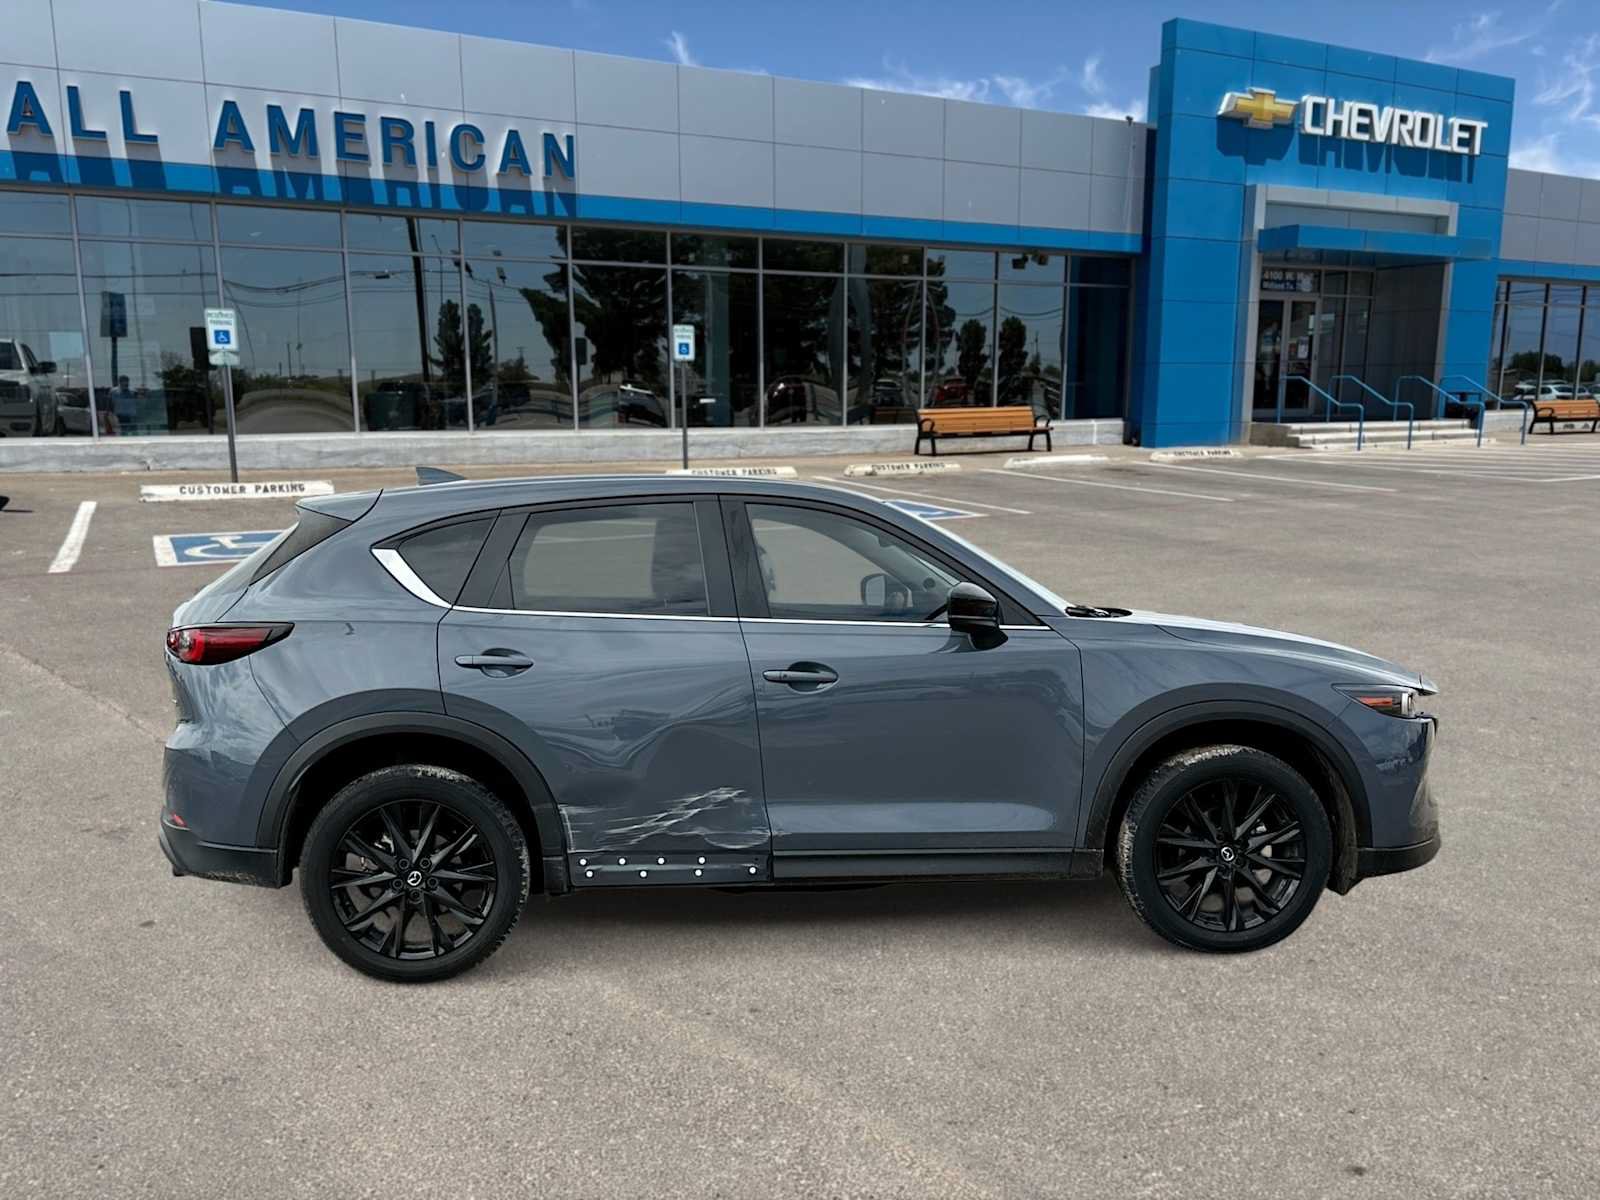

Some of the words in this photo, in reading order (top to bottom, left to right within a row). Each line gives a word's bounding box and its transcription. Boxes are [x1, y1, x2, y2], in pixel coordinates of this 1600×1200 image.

[7, 81, 158, 144] ALL
[213, 100, 575, 179] AMERICAN
[1301, 94, 1488, 155] CHEVROLET
[179, 486, 246, 495] CUSTOMER
[255, 483, 305, 494] PARKING
